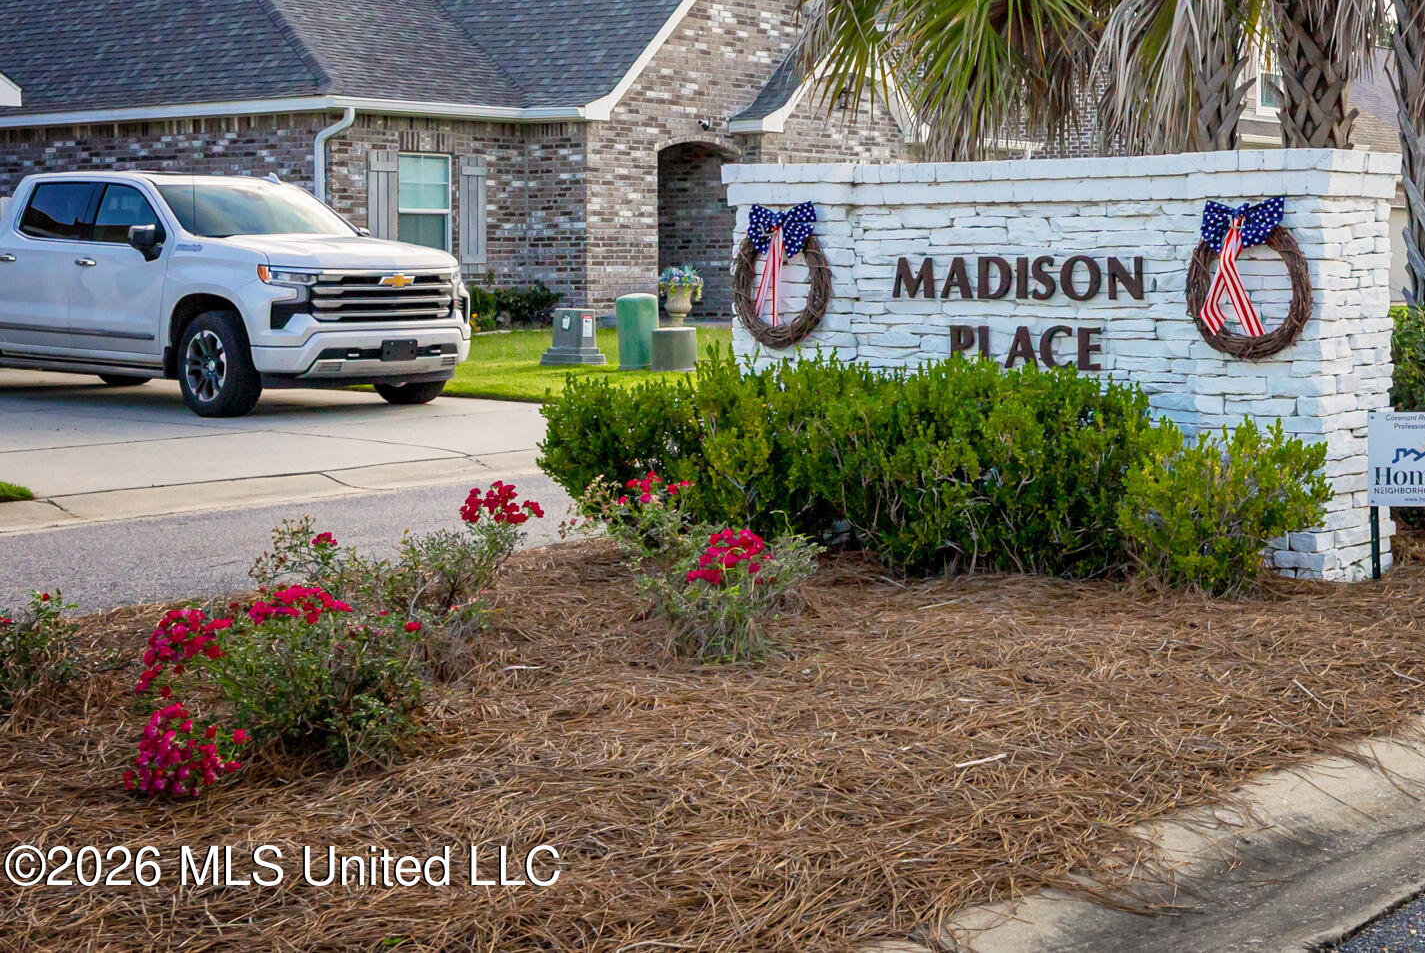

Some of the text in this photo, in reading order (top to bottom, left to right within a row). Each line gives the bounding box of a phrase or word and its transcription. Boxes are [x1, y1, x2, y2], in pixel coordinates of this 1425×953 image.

[892, 254, 1145, 302] MADISON
[950, 325, 1102, 371] PLACE
[1385, 413, 1417, 421] Covenant
